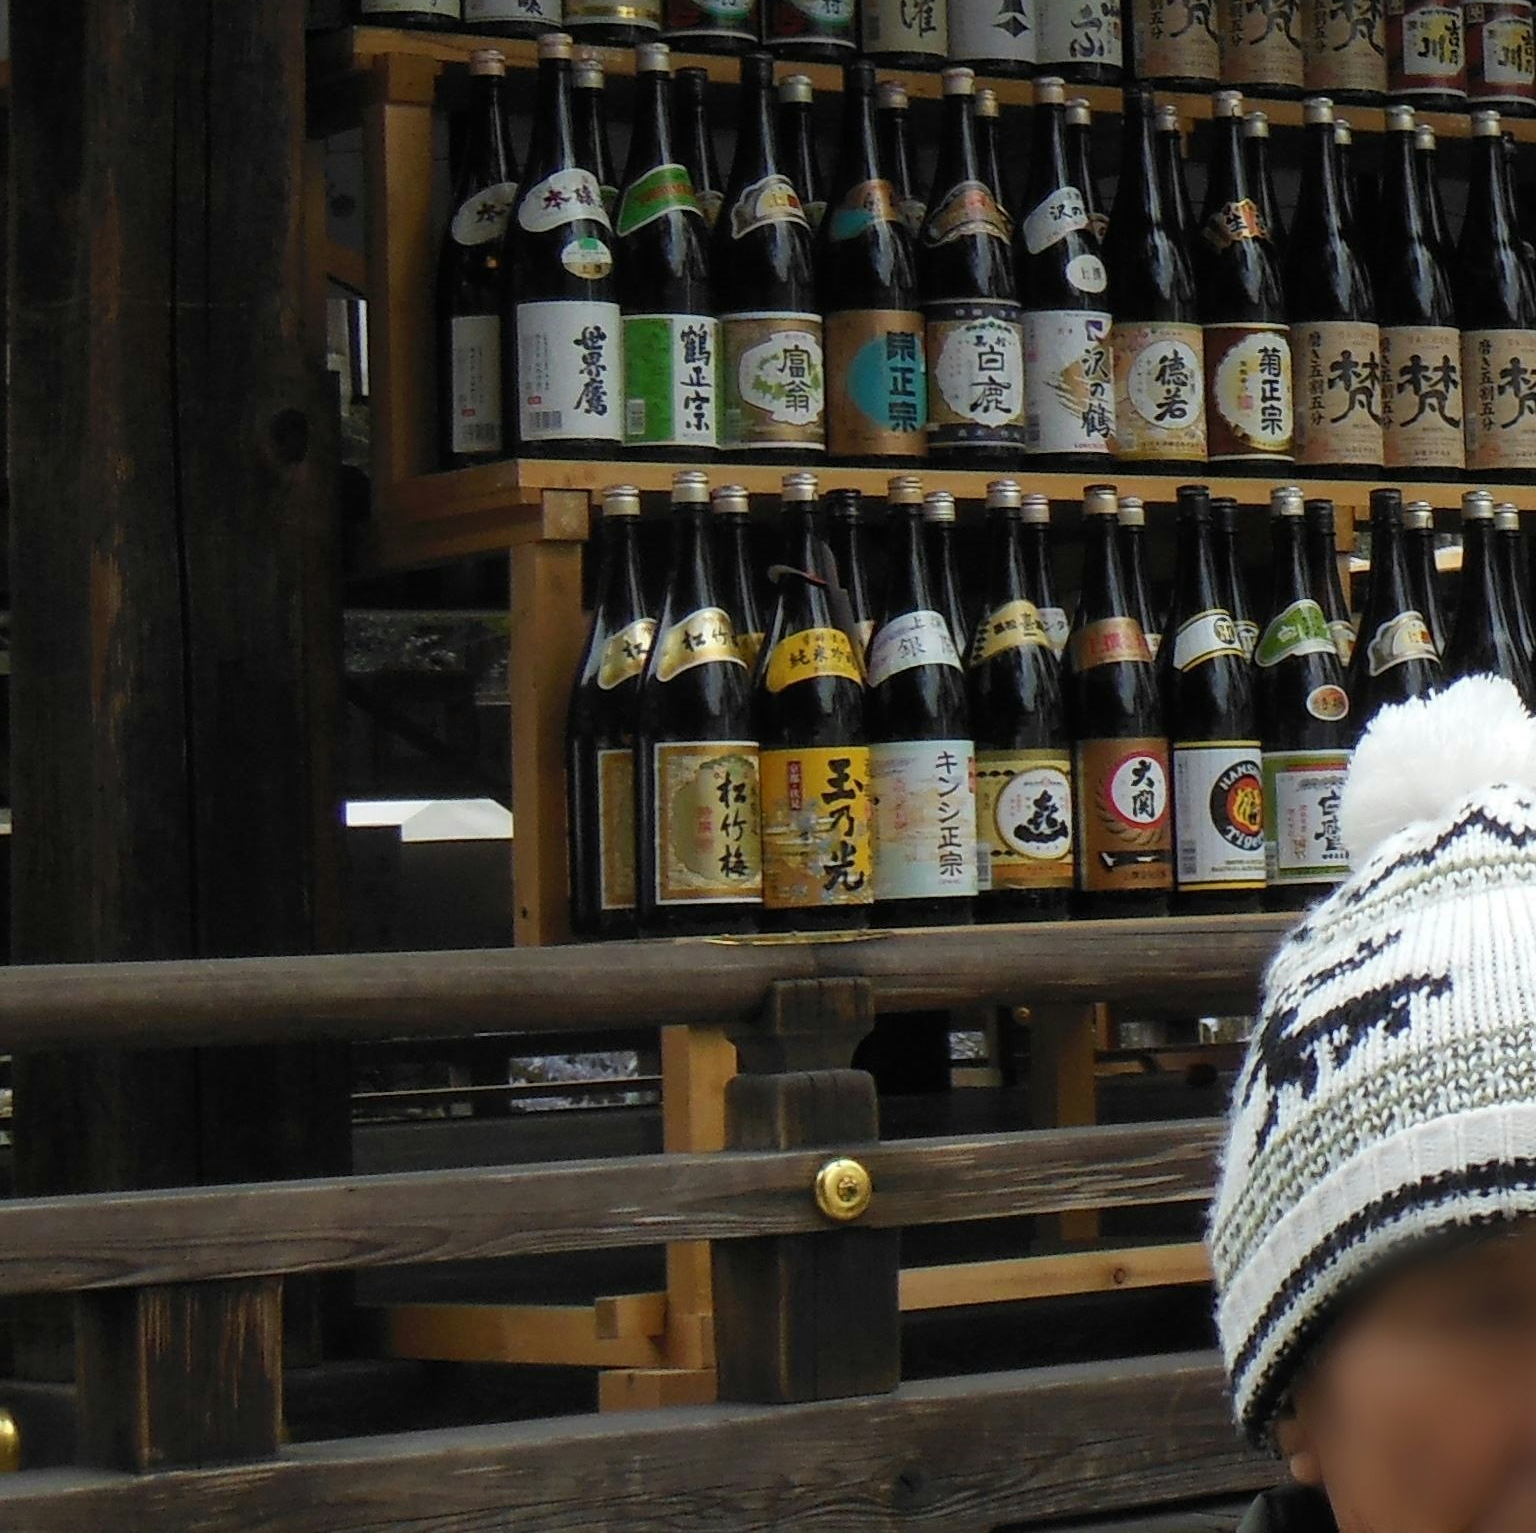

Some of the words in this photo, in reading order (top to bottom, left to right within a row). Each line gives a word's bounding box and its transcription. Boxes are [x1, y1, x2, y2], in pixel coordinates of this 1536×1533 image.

[681, 325, 713, 432] 鶴正宗
[782, 347, 811, 413] 富翁
[969, 347, 1013, 414] 白鹿
[1257, 347, 1284, 434] 菊正宗
[1329, 351, 1382, 424] 梵
[1398, 354, 1461, 428] 梵
[717, 772, 748, 878] 松竹梅
[822, 760, 864, 892] 玉乃光
[936, 749, 962, 877] キンシ正宗
[1130, 760, 1155, 818] 大関
